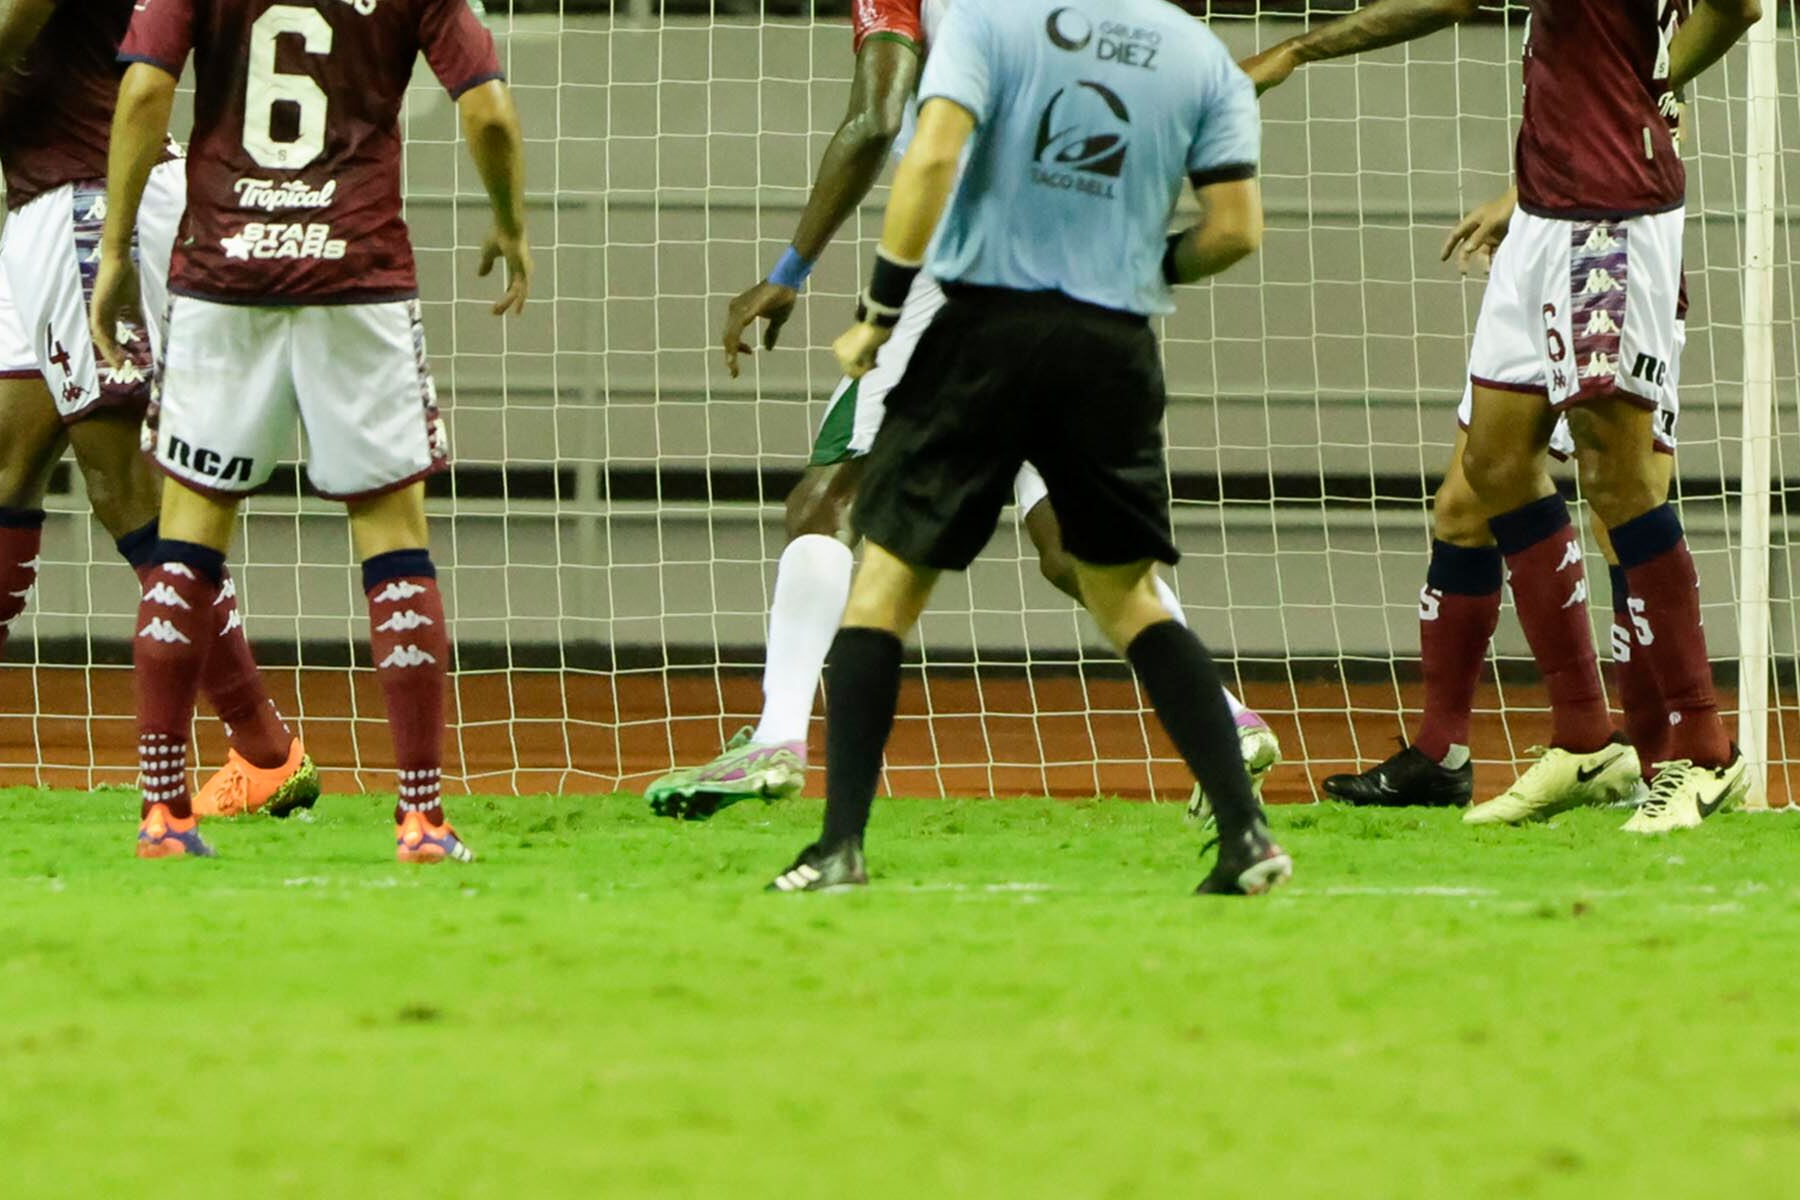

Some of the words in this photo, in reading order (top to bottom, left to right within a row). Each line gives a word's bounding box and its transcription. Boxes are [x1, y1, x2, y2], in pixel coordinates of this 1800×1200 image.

[1098, 20, 1163, 46] GRUPO
[1095, 37, 1161, 71] DIEZ
[241, 4, 334, 170] 6
[234, 177, 338, 211] Tropical
[240, 223, 331, 241] STAR
[249, 239, 348, 260] CARS
[167, 434, 255, 484] RCA
[1627, 596, 1655, 647] S
